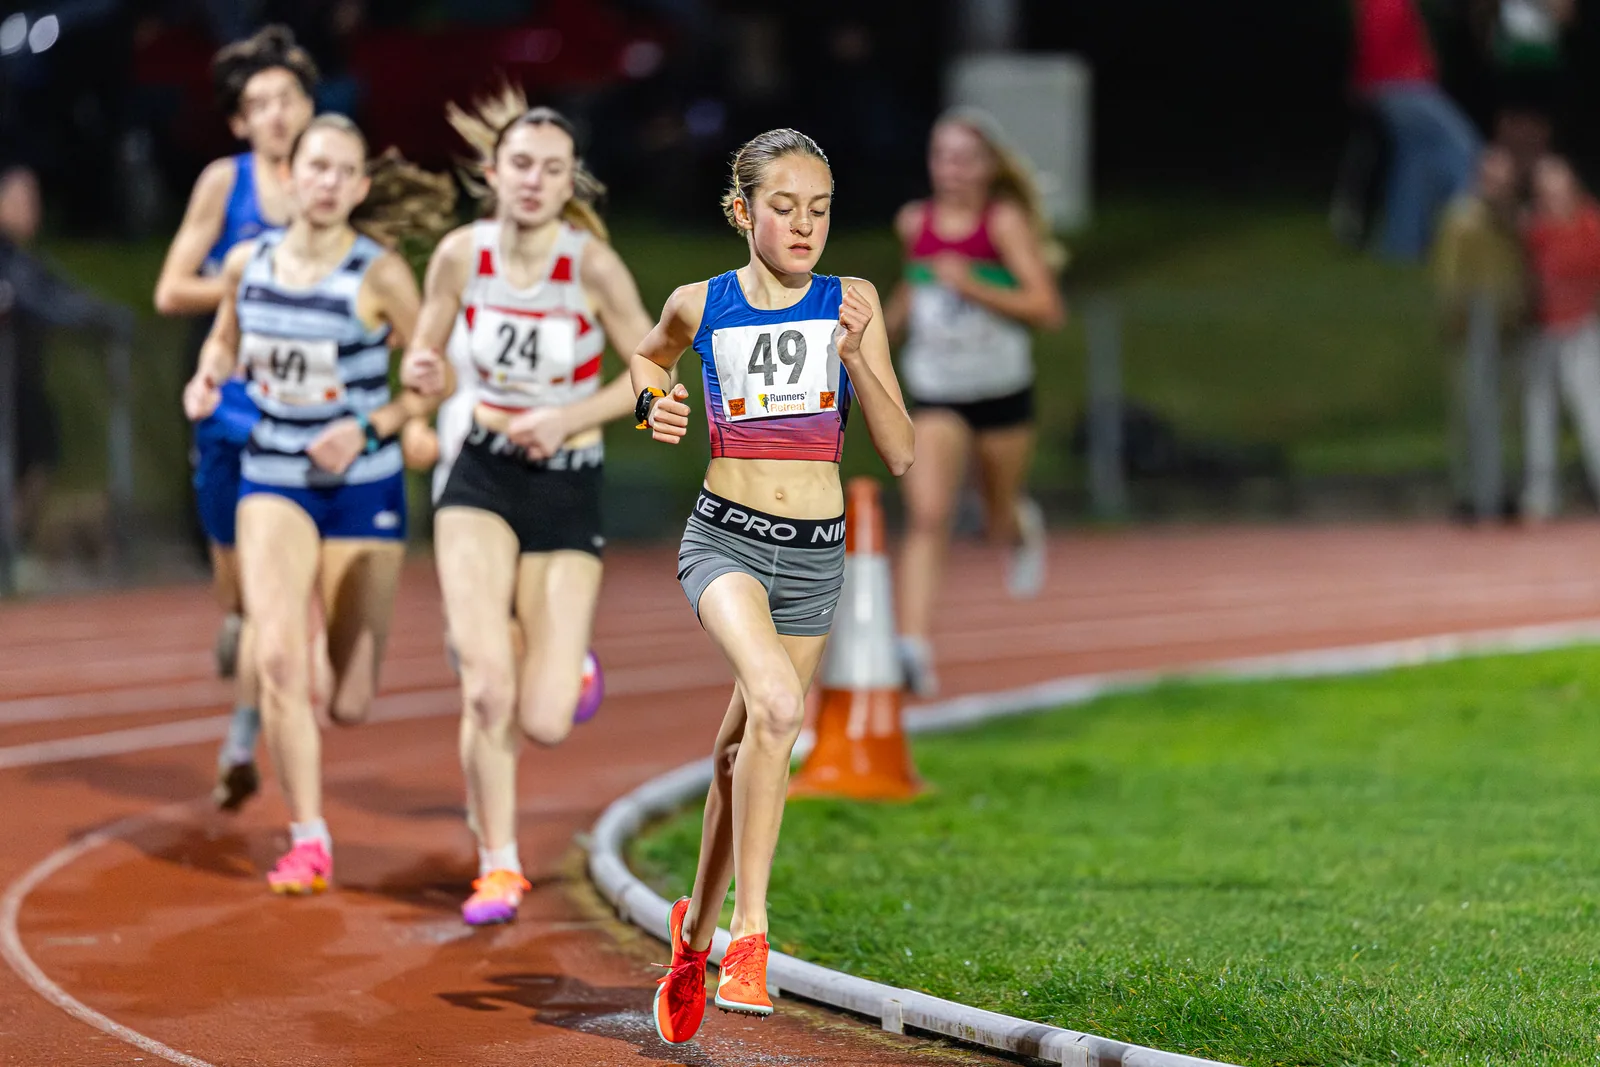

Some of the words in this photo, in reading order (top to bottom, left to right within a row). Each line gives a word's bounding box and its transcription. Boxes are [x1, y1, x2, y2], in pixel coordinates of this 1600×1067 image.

[497, 321, 540, 371] 24
[747, 330, 808, 386] 49
[769, 391, 808, 402] Runners'
[769, 402, 806, 413] Retreat
[721, 507, 798, 541] PRO
